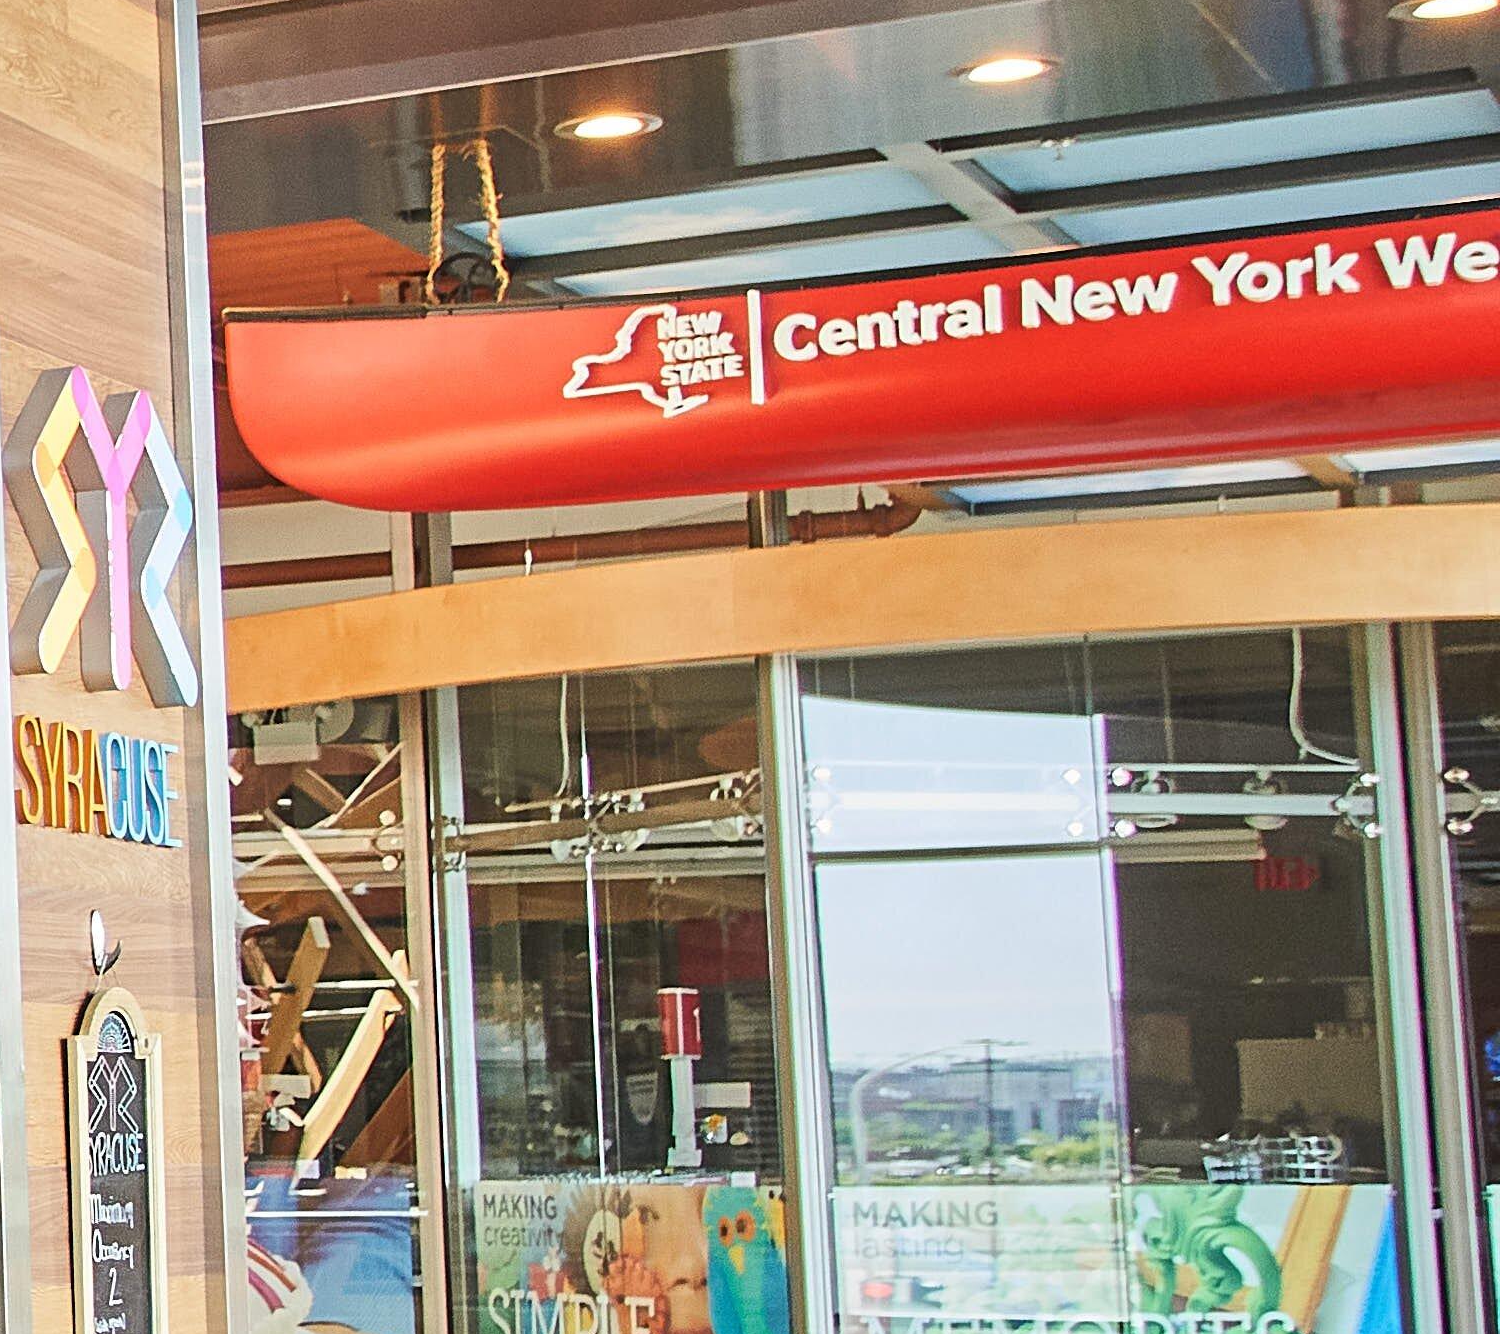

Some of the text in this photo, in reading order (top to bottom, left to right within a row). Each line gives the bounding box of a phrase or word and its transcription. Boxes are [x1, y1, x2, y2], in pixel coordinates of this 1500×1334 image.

[773, 284, 1001, 362] Central
[1021, 272, 1178, 330] New
[1191, 243, 1361, 306] York
[658, 310, 722, 339] NEW
[658, 332, 735, 362] YORK
[660, 354, 744, 386] STATE
[16, 715, 182, 848] SYRACUSE
[482, 1193, 559, 1221] MAKING
[851, 1198, 999, 1229] MAKING
[852, 1229, 966, 1264] lasting
